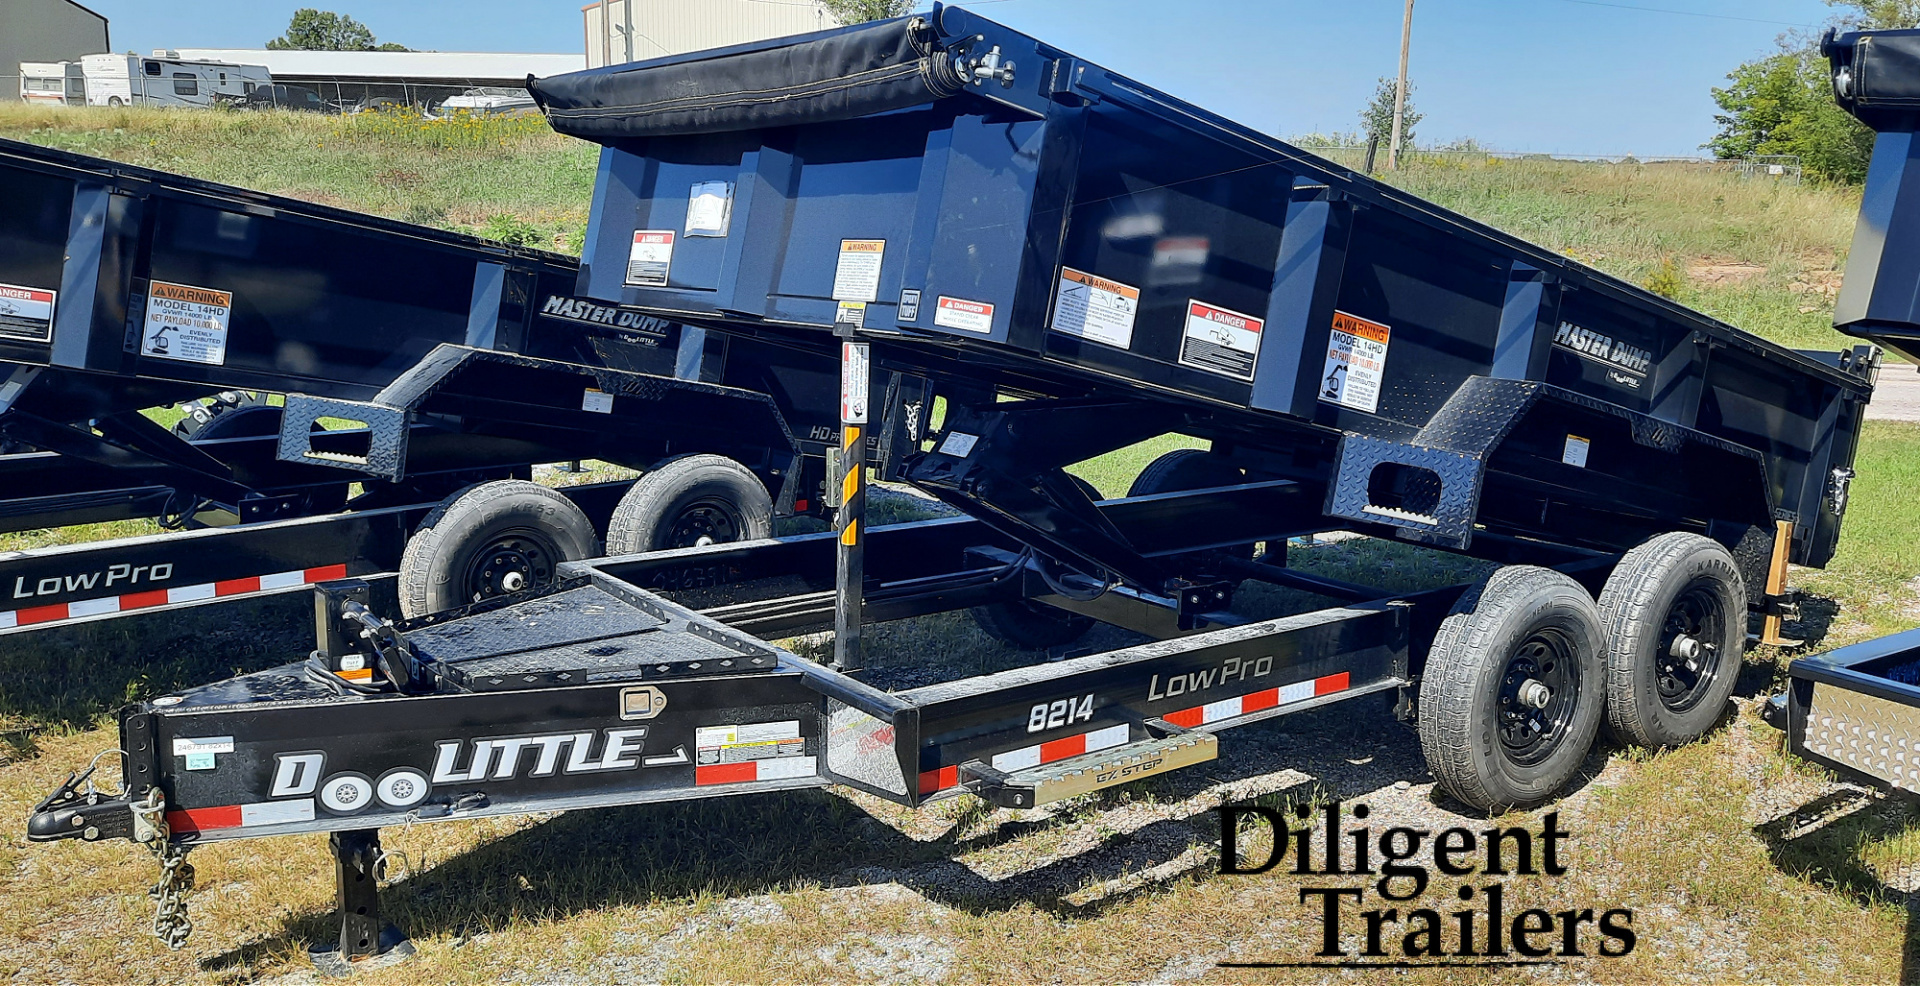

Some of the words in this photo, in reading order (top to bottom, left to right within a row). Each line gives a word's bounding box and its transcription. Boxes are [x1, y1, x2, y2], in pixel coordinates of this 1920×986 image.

[853, 243, 877, 251] WARNING
[0, 289, 31, 299] NGER
[1088, 277, 1122, 294] WARNING
[167, 287, 225, 305] WARNING
[153, 299, 193, 312] MODEL
[198, 305, 225, 316] 14HD
[543, 295, 617, 324] MASTER
[954, 302, 984, 313] DANGER
[151, 314, 163, 323] NET
[164, 315, 191, 326] PAYLOAD
[1214, 312, 1246, 329] DANGER
[189, 330, 213, 338] EVENLY
[1344, 318, 1384, 341] WARNING
[180, 334, 221, 345] DISTRIBUTED
[1332, 332, 1361, 348] MODEL
[1364, 341, 1383, 354] 14HD
[1553, 320, 1613, 359] MASTER
[809, 425, 831, 440] HD
[1027, 693, 1095, 733] 8214
[1096, 769, 1118, 783] EZ
[1121, 758, 1163, 777] STEP
